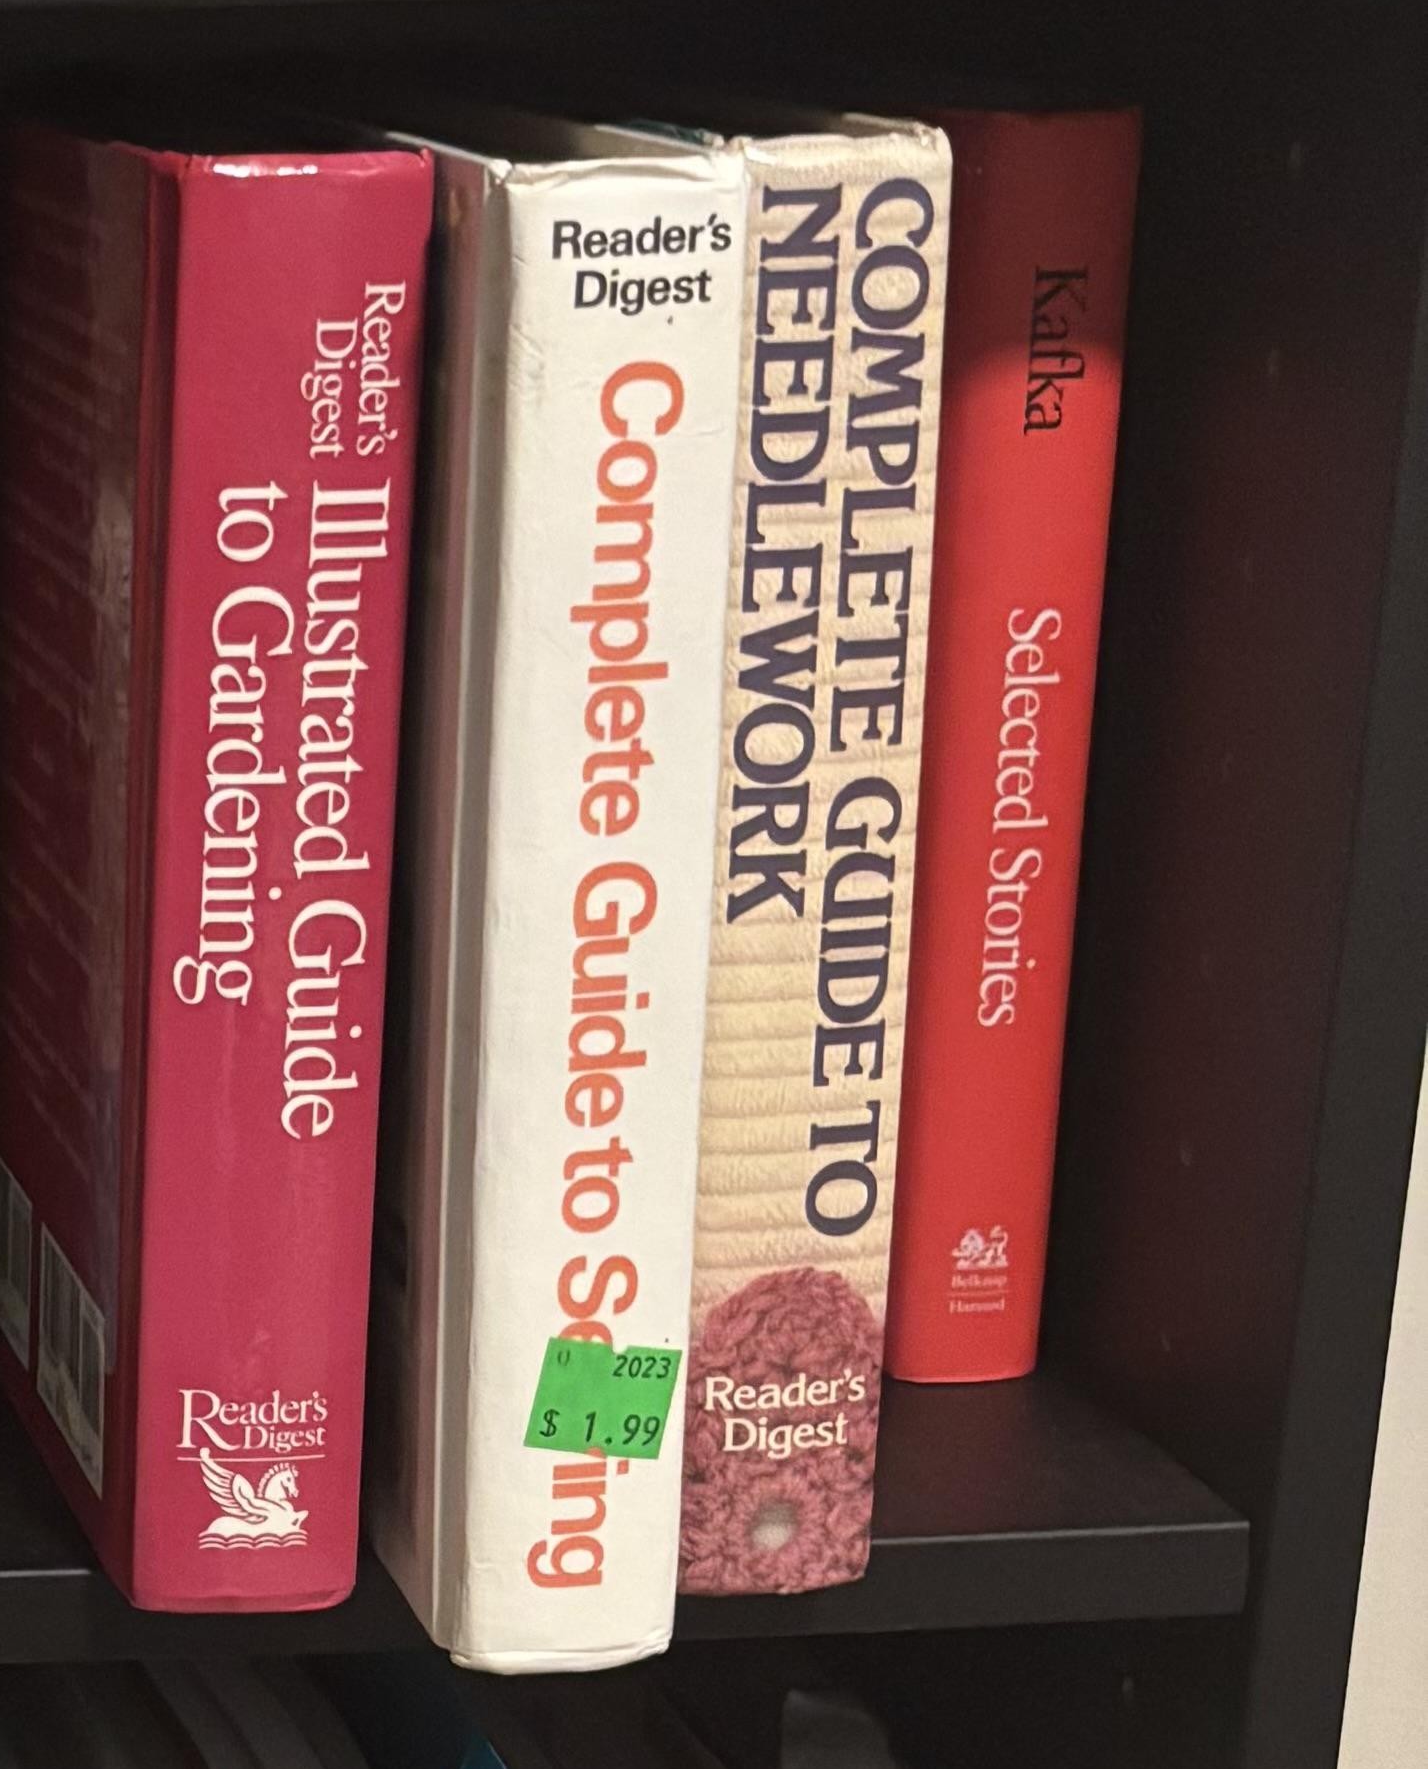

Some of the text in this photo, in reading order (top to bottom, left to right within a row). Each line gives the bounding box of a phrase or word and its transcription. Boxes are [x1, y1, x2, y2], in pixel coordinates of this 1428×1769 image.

[573, 268, 712, 315] Digest
[724, 182, 843, 926] NEEDLEWORK
[173, 480, 296, 1007] to Gardening
[279, 477, 391, 1140] Illustrated Guide
[977, 266, 1089, 1028] Kafka Selected Stories
[705, 1369, 866, 1410] Reader's
[723, 1415, 849, 1459] Digest
